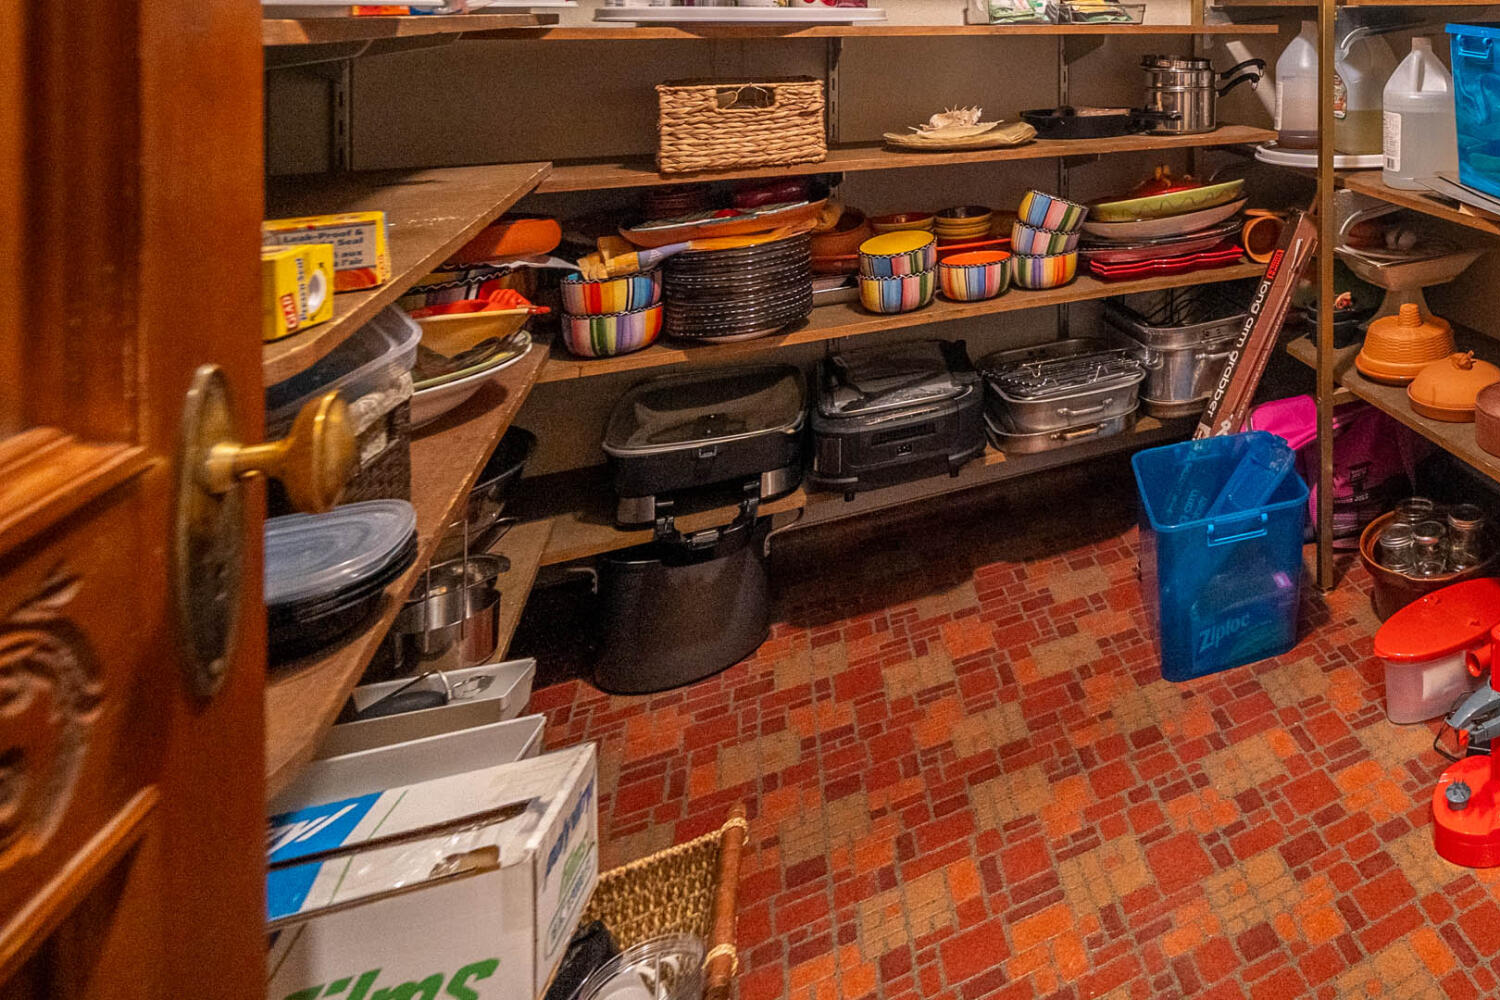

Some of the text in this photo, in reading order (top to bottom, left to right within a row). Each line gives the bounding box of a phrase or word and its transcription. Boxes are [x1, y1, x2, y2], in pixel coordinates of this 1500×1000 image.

[1207, 280, 1271, 418] long arm grabber
[1199, 612, 1250, 653] Ziploc
